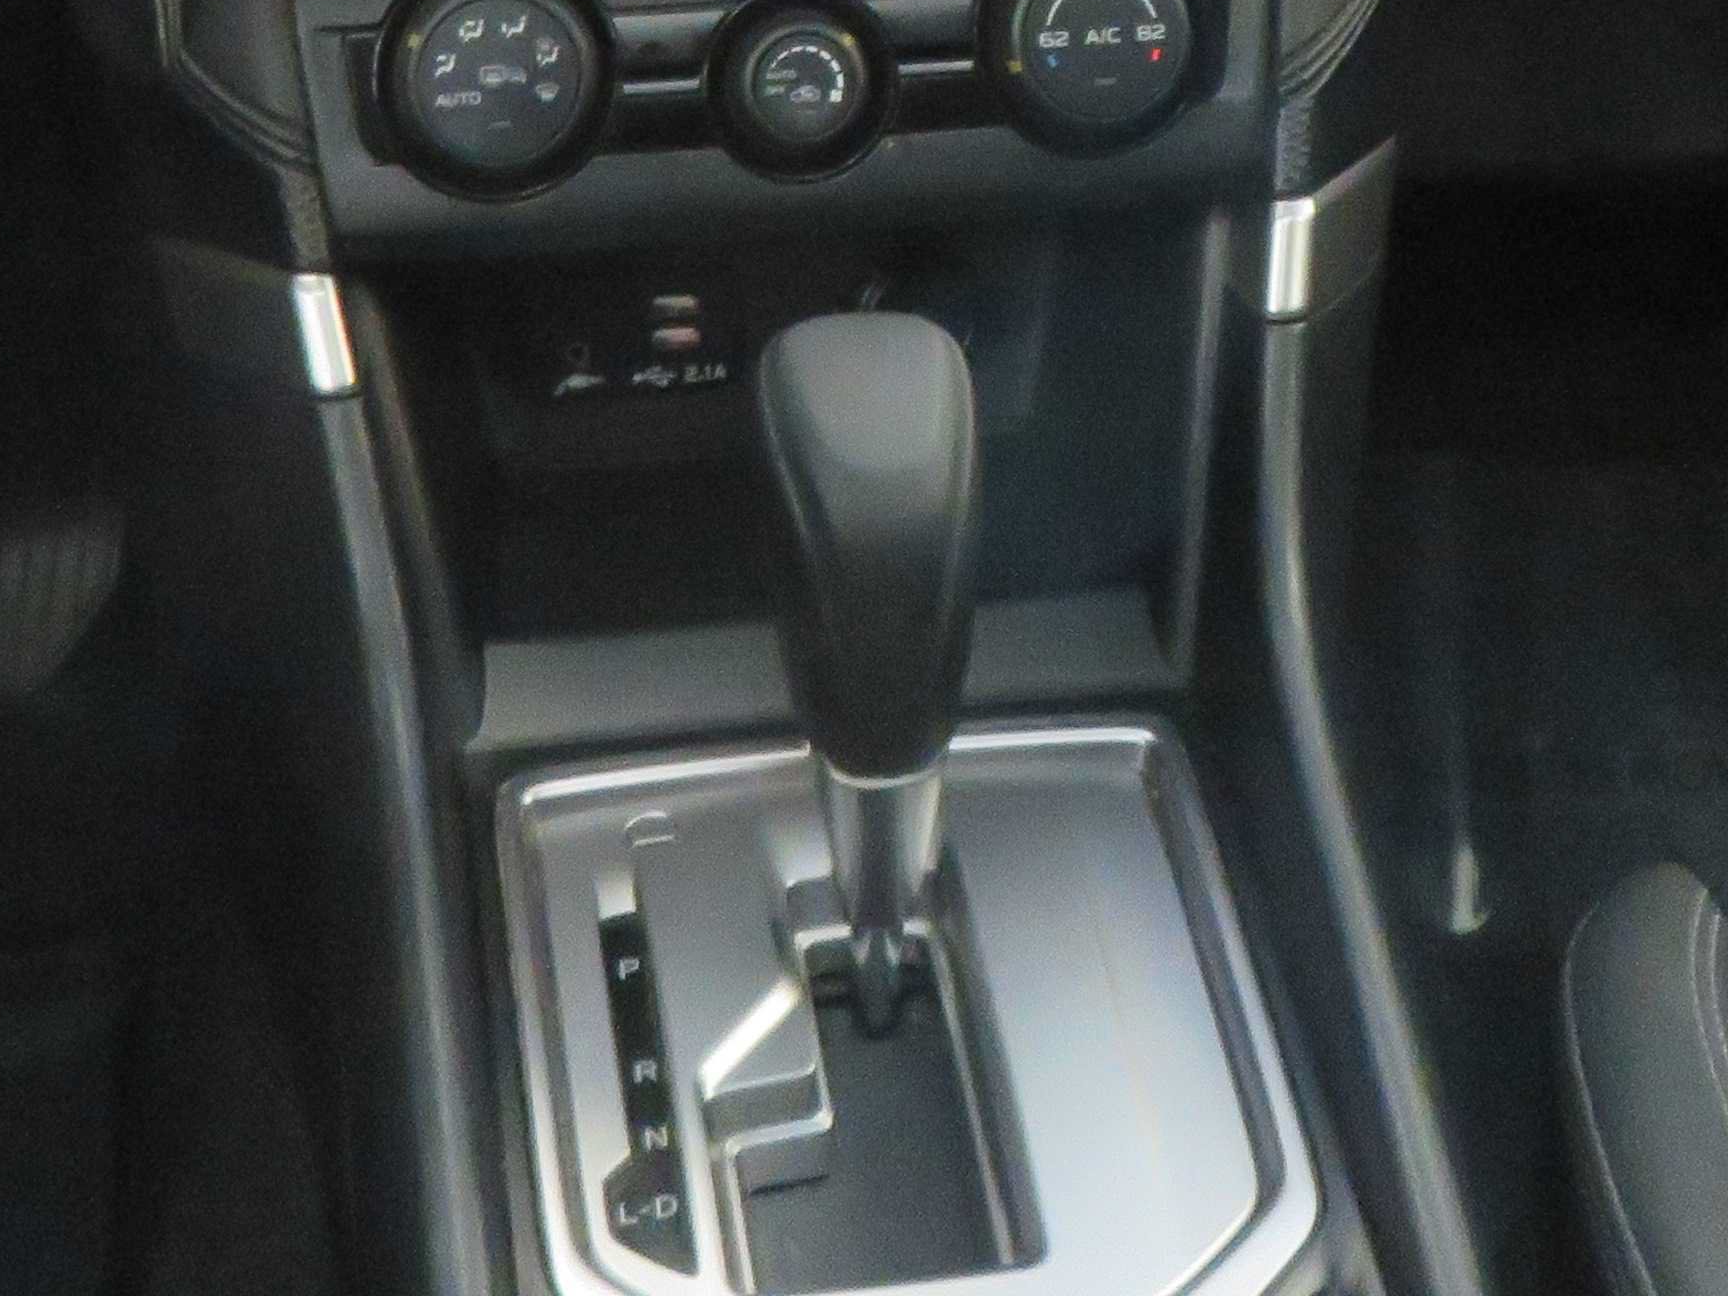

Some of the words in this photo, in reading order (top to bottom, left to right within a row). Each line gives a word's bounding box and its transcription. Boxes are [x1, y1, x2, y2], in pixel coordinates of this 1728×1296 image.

[1039, 31, 1069, 48] 62
[1083, 27, 1122, 46] A/C
[1135, 23, 1166, 42] 82
[435, 90, 482, 108] AUTO
[618, 958, 641, 981] P
[632, 1060, 658, 1084] R
[644, 1125, 668, 1152] N
